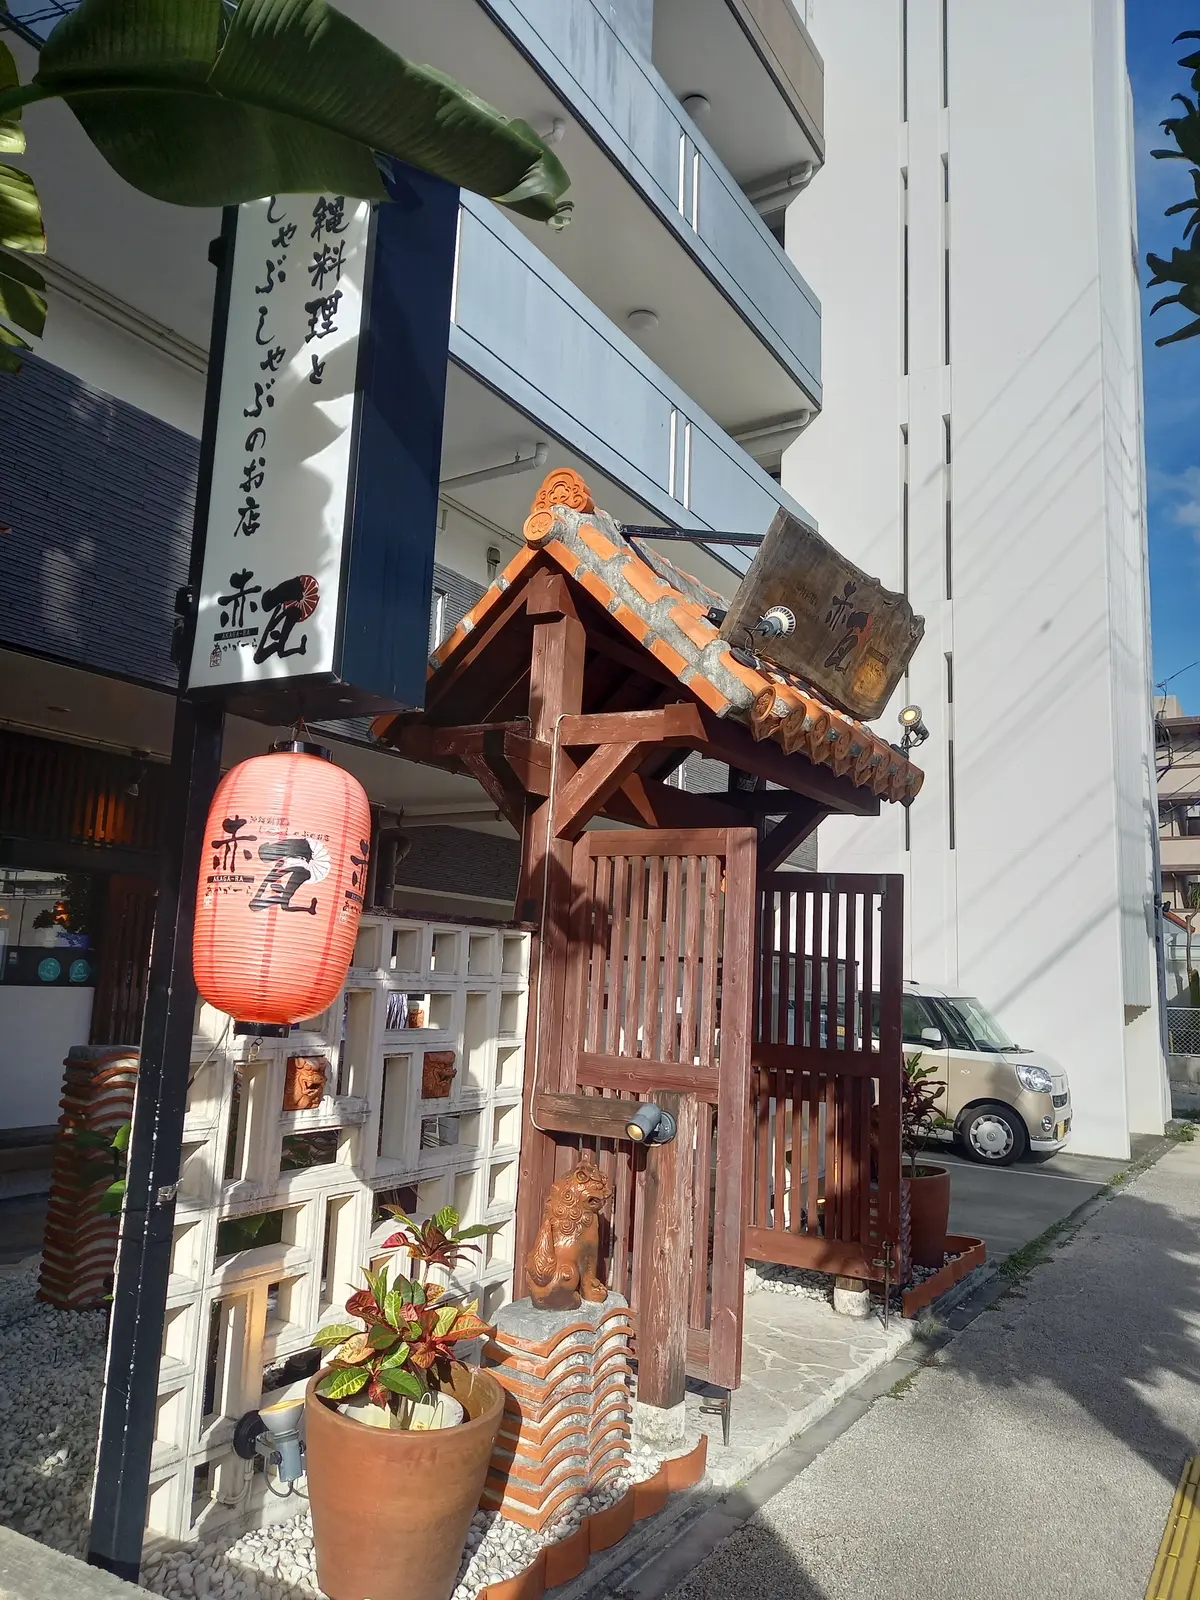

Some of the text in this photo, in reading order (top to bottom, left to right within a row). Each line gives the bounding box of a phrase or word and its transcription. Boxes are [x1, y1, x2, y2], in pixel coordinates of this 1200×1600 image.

[234, 195, 297, 538] しゃぶしゃぶのお店
[305, 196, 349, 384] 縄料理と
